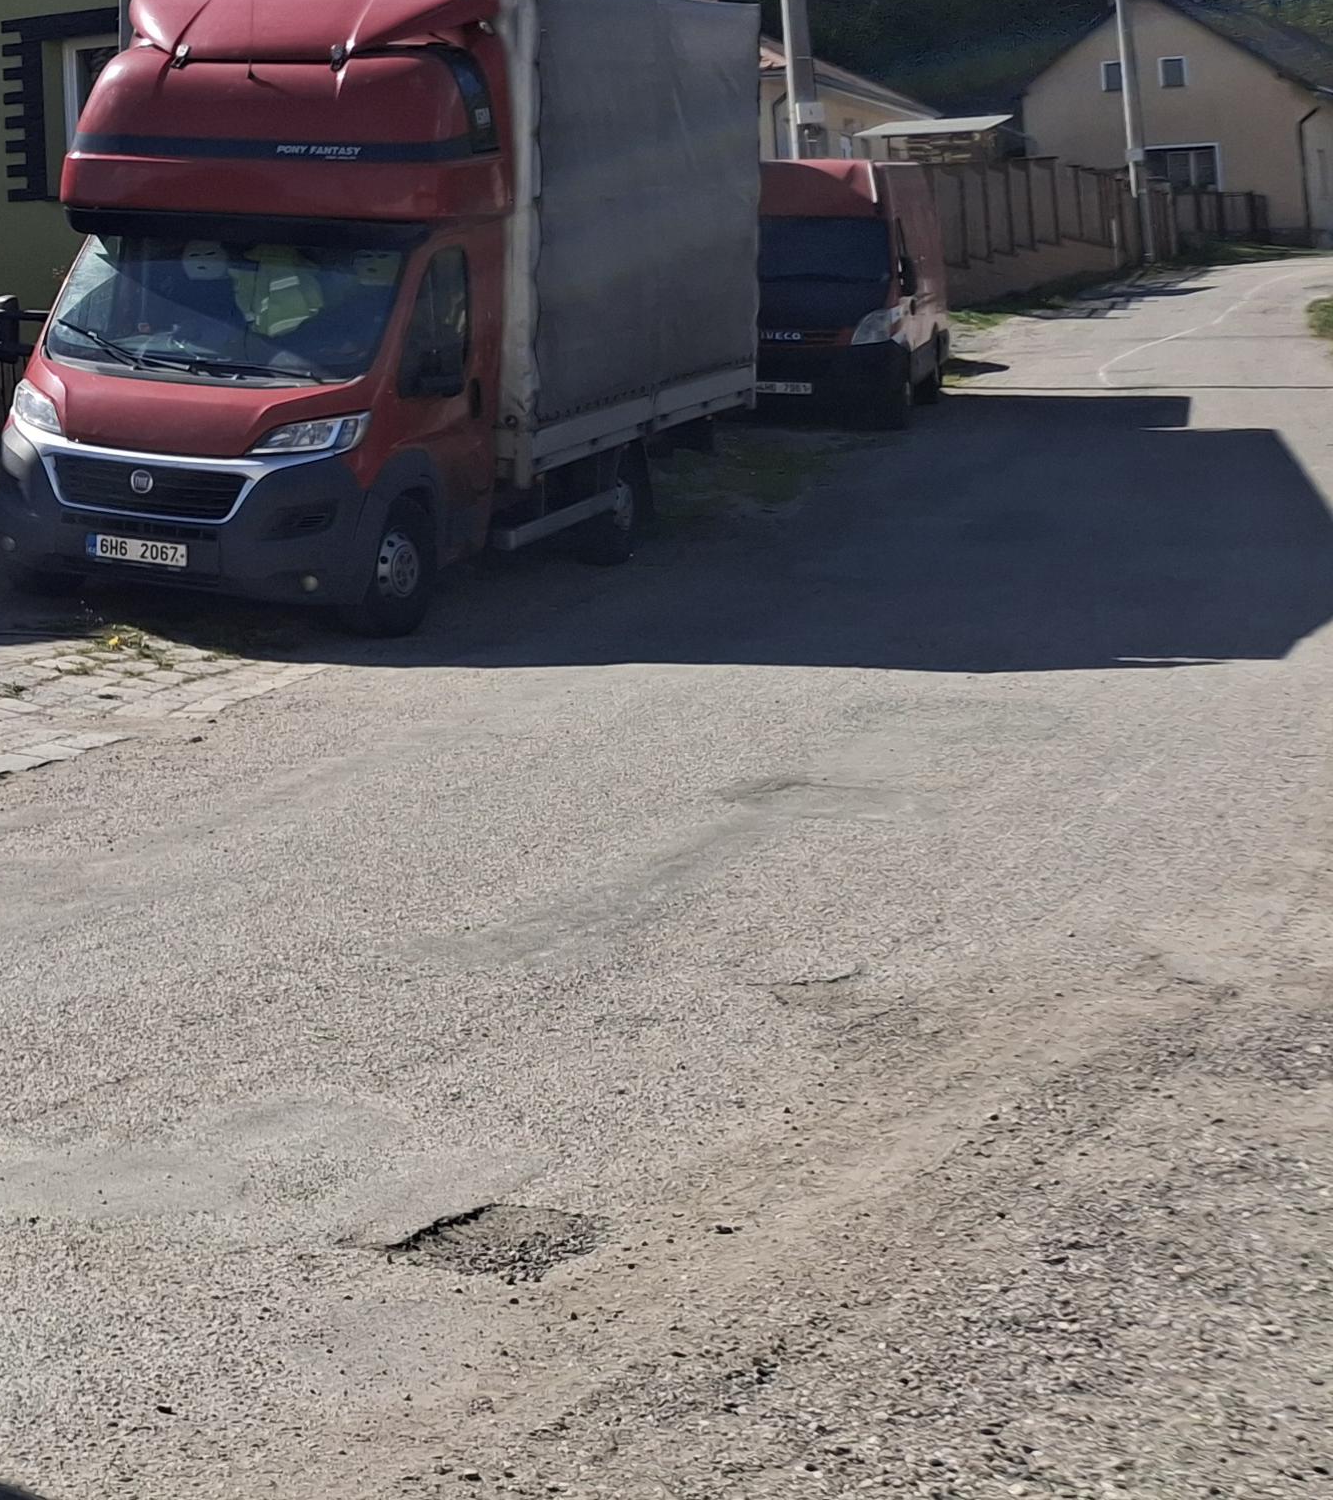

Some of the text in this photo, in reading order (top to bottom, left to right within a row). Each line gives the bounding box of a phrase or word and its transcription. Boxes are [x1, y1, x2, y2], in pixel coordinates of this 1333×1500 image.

[276, 145, 361, 155] PONY FANTASY
[760, 332, 801, 340] IVECO
[100, 538, 128, 556] 6H6
[140, 543, 178, 562] 2067
